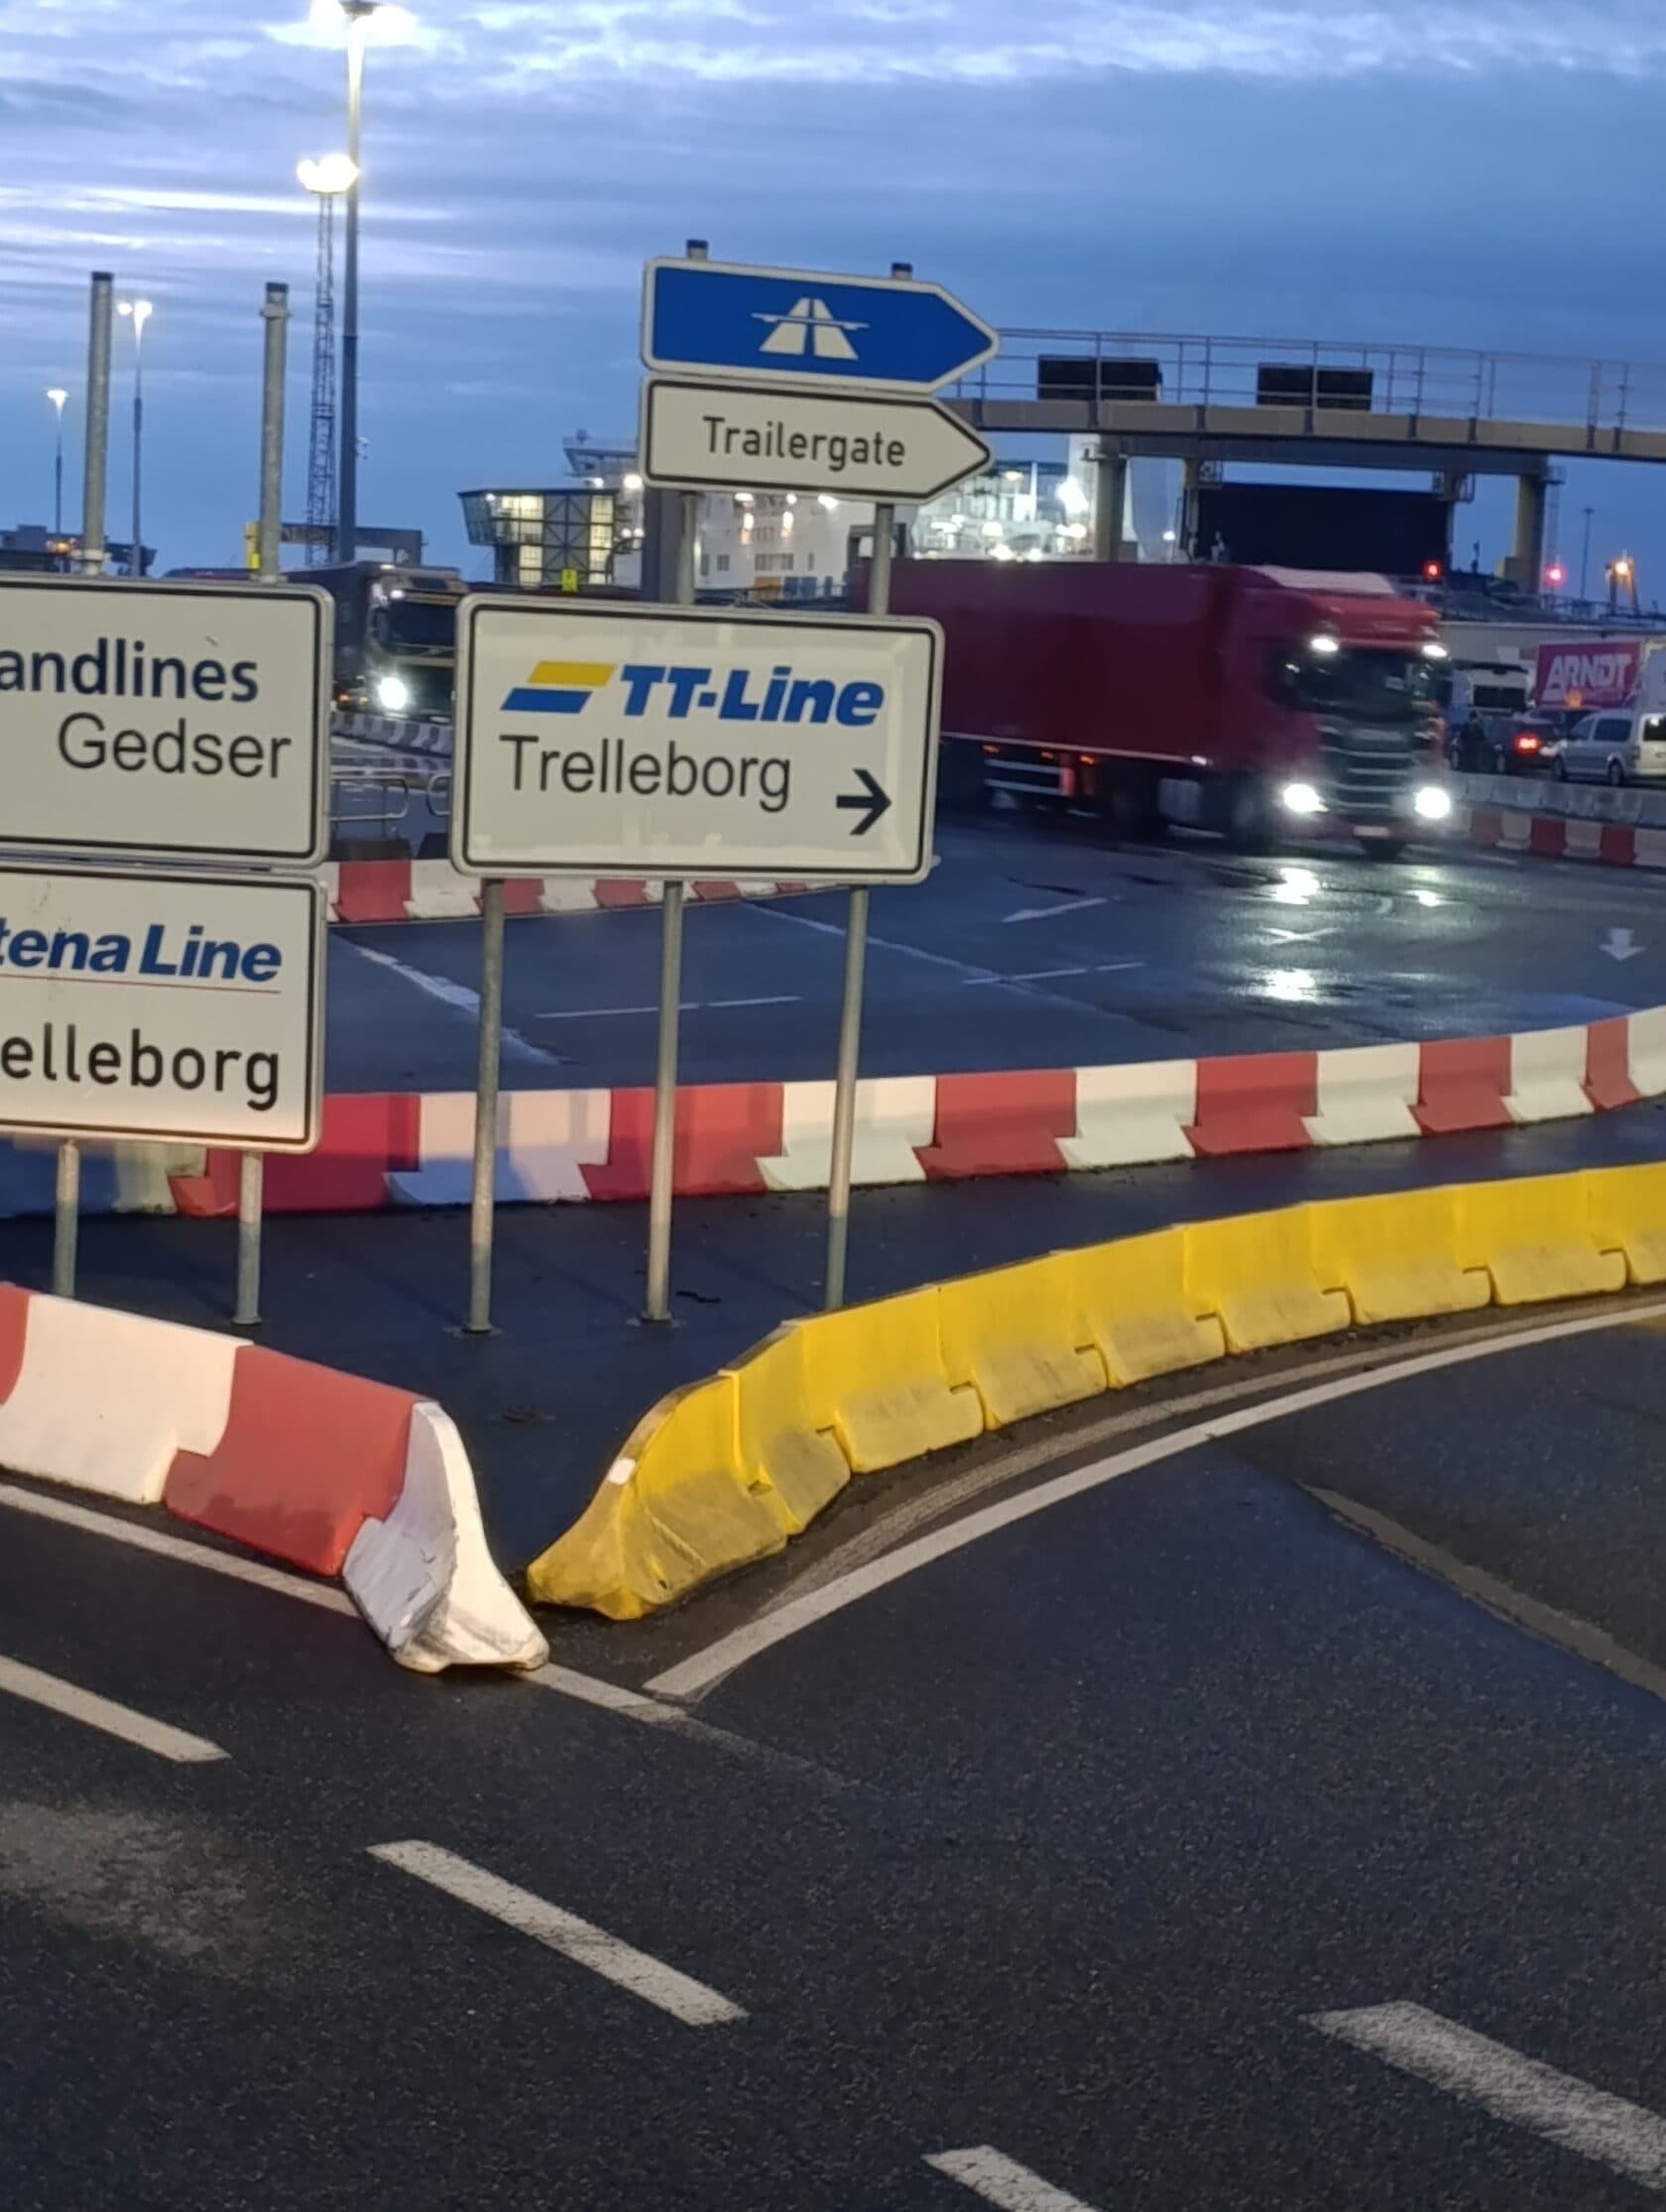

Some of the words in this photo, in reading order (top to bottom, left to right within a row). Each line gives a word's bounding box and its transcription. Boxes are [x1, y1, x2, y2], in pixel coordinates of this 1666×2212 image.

[701, 415, 905, 472] Trailergate
[620, 664, 885, 727] TT-Line
[1541, 653, 1632, 701] ARNDT
[58, 711, 293, 778] Gedser
[499, 734, 791, 813] Trelleborg
[138, 923, 283, 983] Line
[0, 1023, 280, 1111] elleborg
